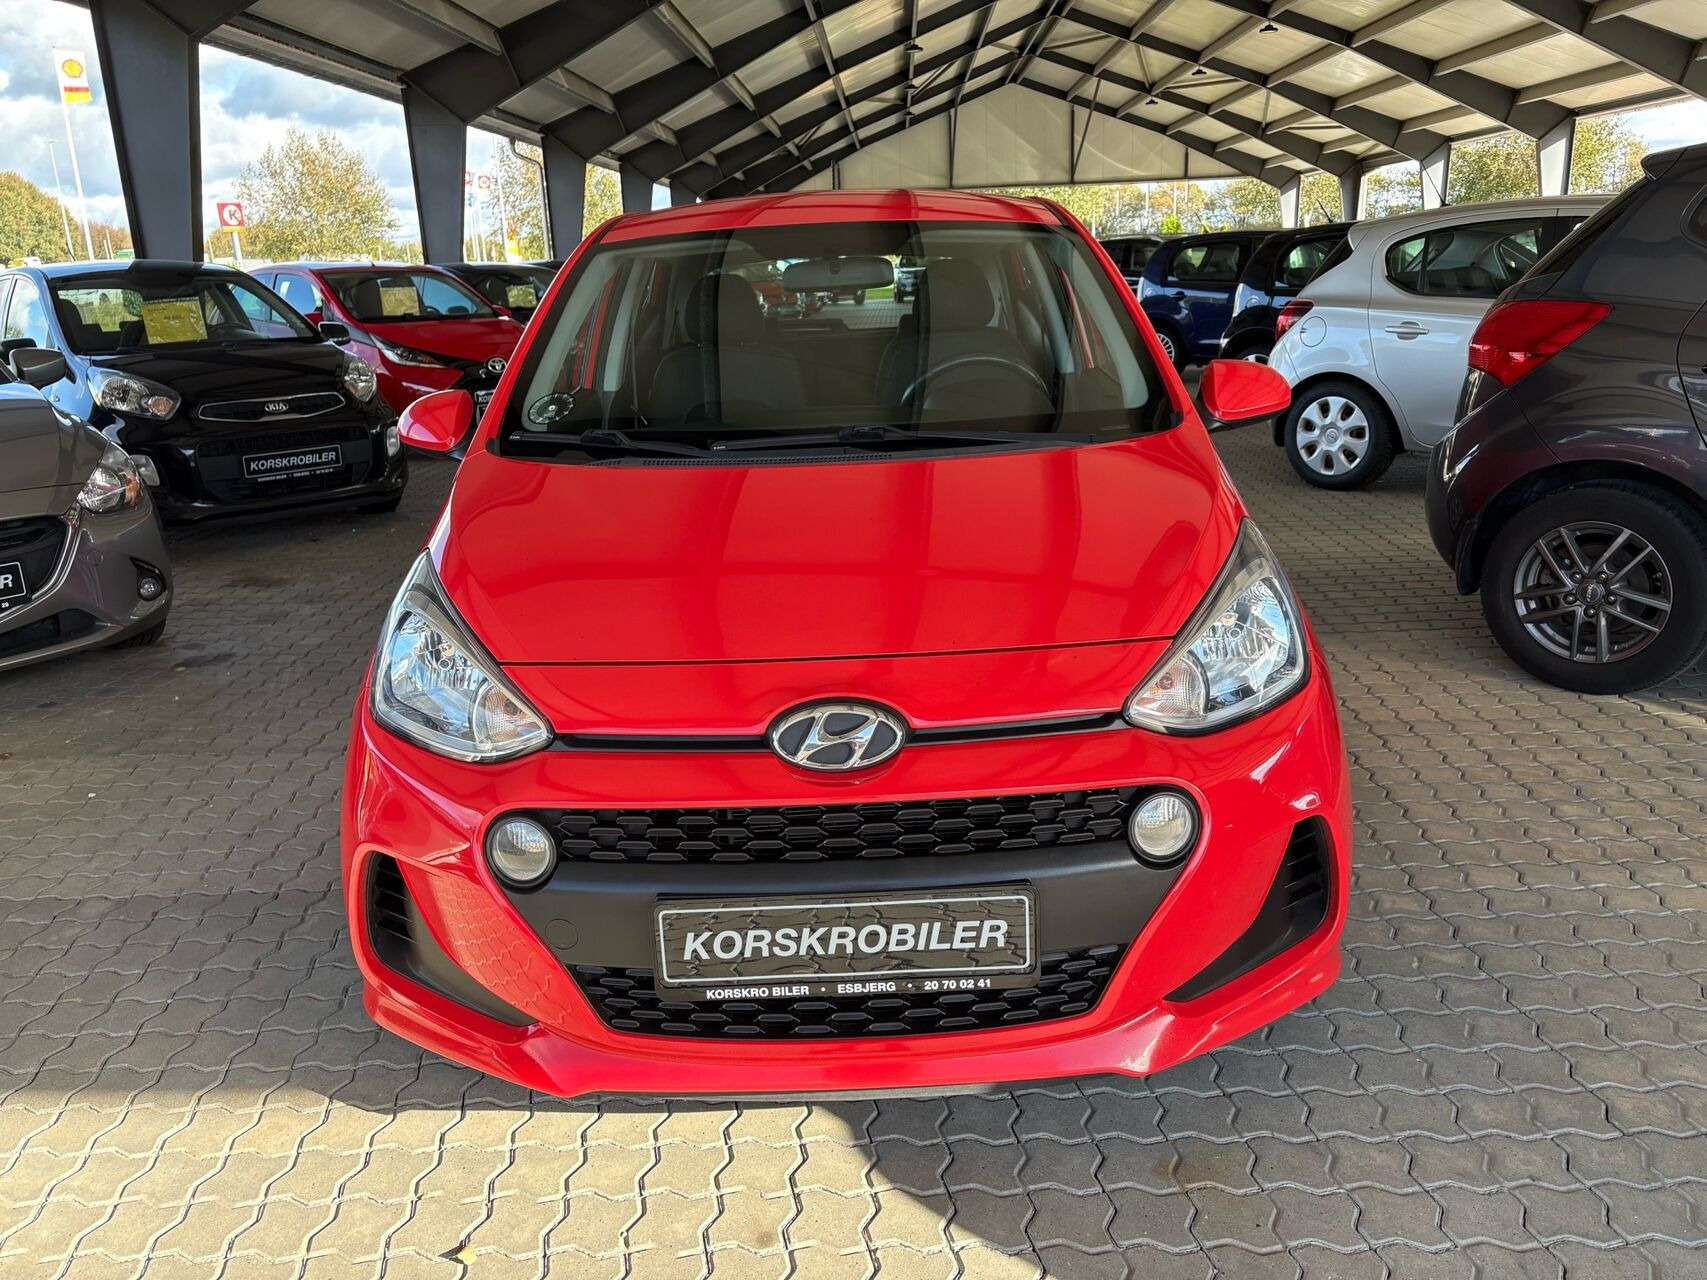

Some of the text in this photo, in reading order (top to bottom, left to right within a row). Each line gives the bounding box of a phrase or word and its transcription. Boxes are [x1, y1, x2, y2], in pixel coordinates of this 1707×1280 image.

[268, 402, 287, 412] KIA
[250, 451, 336, 472] KORSKROBILER
[683, 919, 1008, 960] KORSKROBILER
[706, 978, 991, 1000] KORSKRO BILER ESBJERG 20 70 02 41
